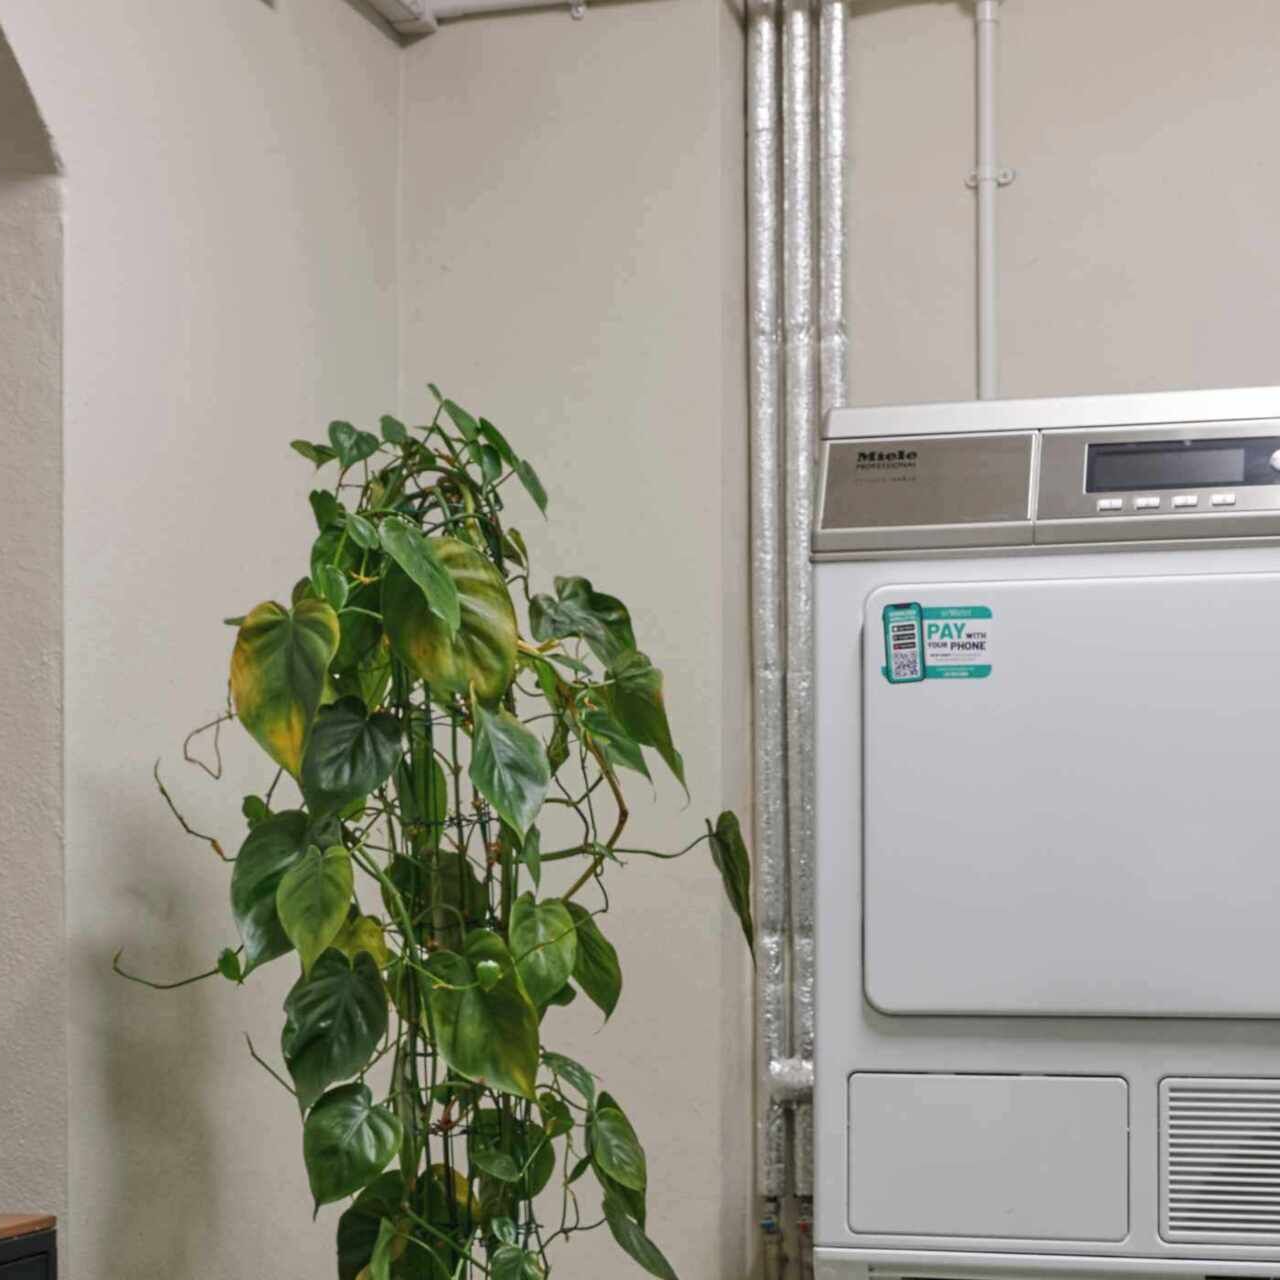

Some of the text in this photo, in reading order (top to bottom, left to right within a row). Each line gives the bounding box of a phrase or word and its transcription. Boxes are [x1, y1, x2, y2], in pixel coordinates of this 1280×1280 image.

[857, 450, 918, 462] Miele
[927, 622, 966, 640] PAY
[966, 631, 987, 640] WITH
[928, 640, 986, 651] YOUR PHONE
